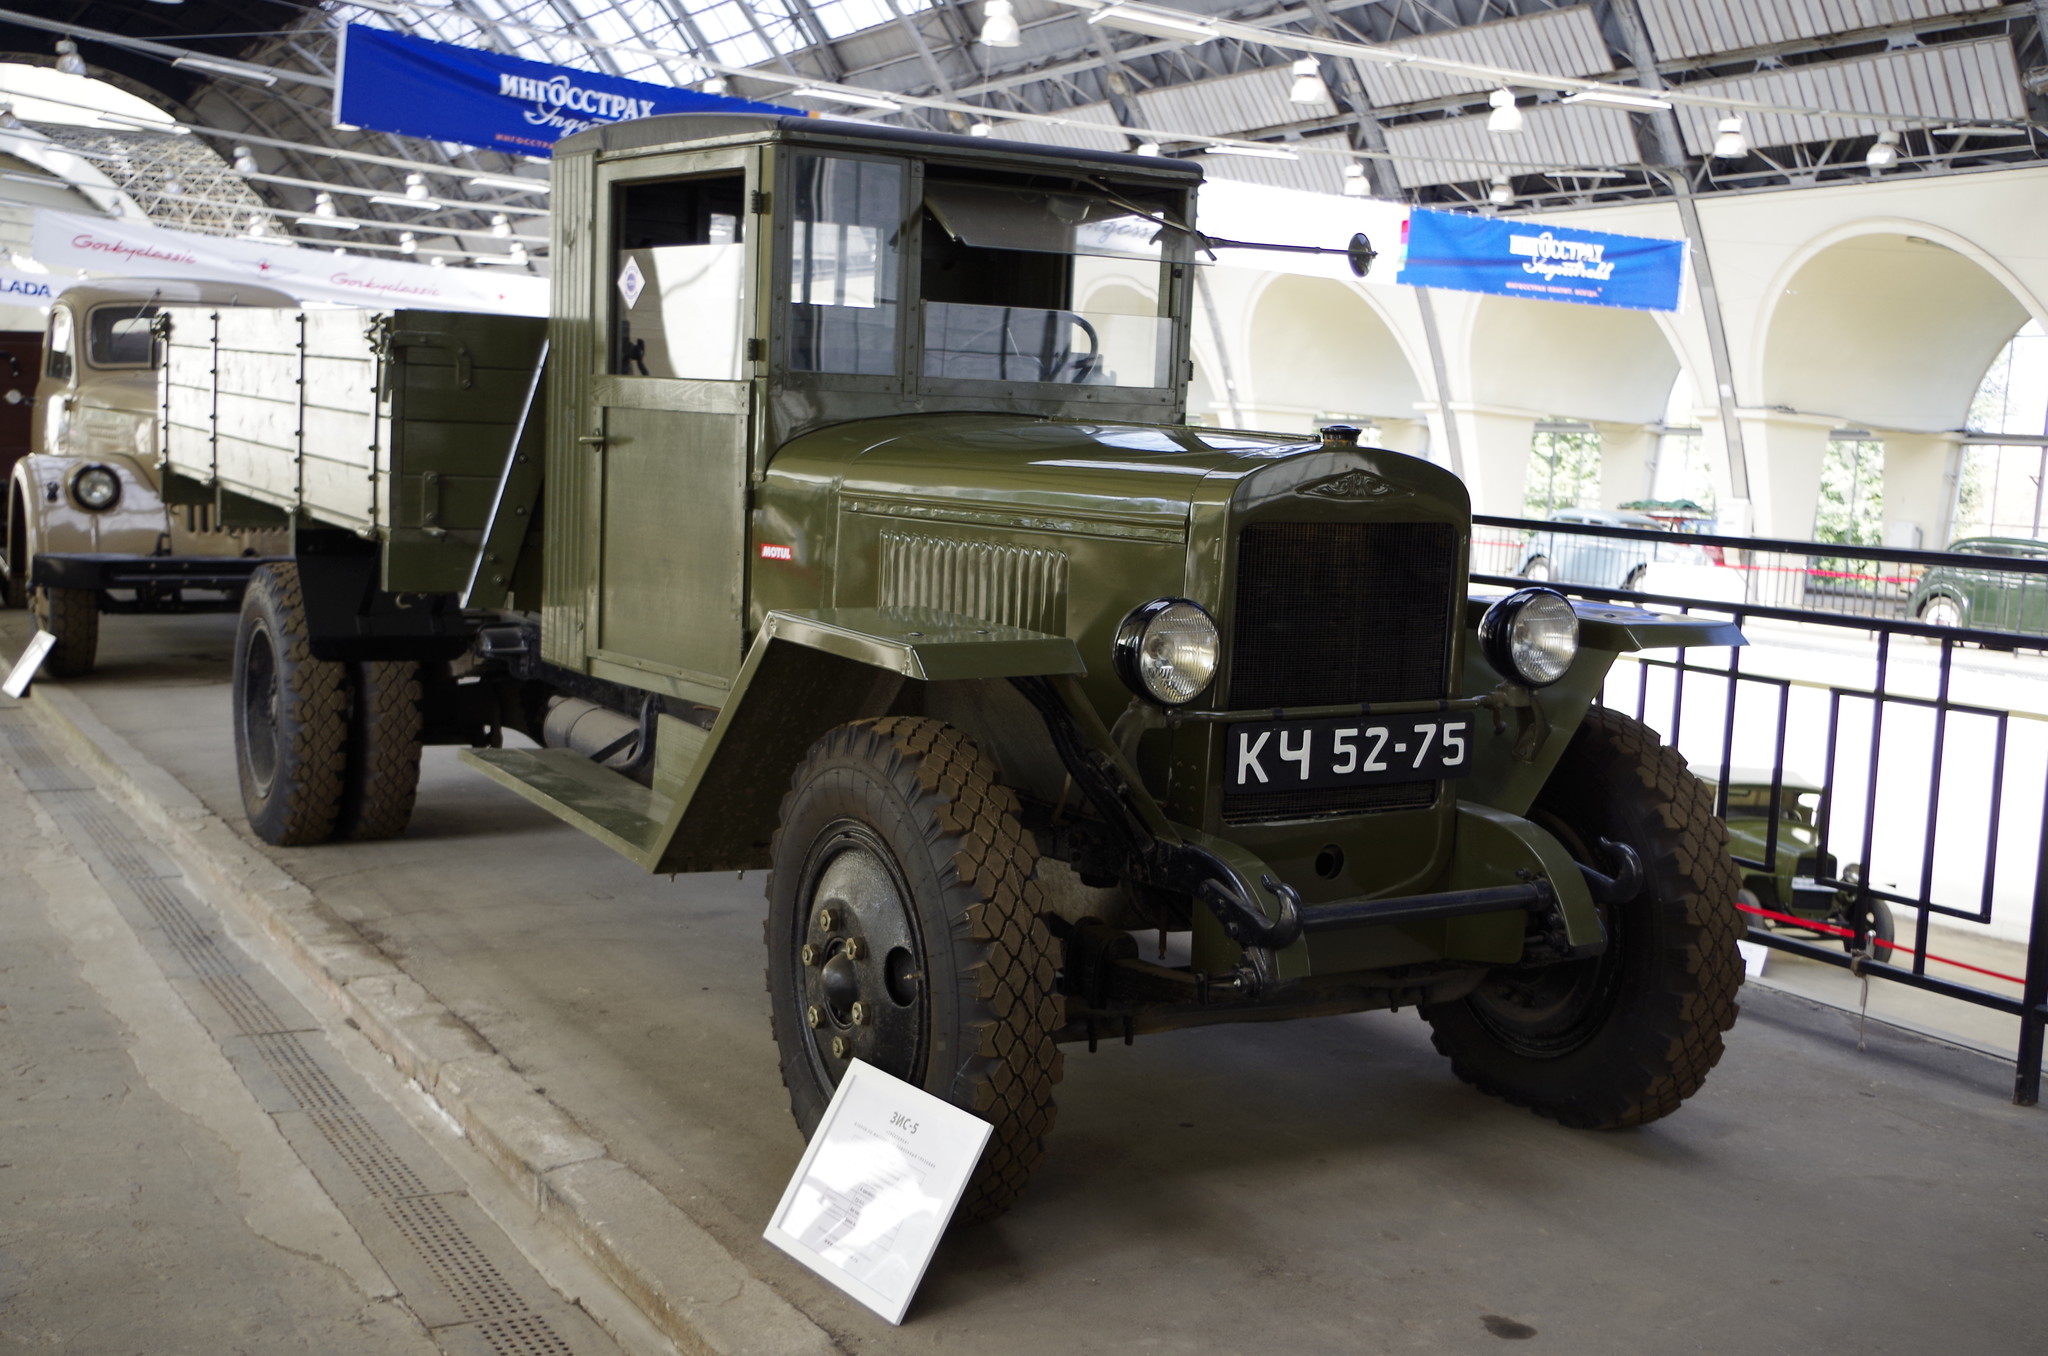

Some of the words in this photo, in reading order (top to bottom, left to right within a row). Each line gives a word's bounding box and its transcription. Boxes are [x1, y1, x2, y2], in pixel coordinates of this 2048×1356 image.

[499, 73, 656, 120] ИНГОССТРАХ
[495, 133, 554, 150] ИНГОССТРА
[72, 234, 197, 265] Gorkyclassic
[0, 277, 52, 298] LADA
[761, 545, 791, 560] MOTUL
[1237, 729, 1312, 785] КЧ
[1332, 722, 1466, 774] 52-75
[889, 1111, 920, 1135] ЗИС-5
